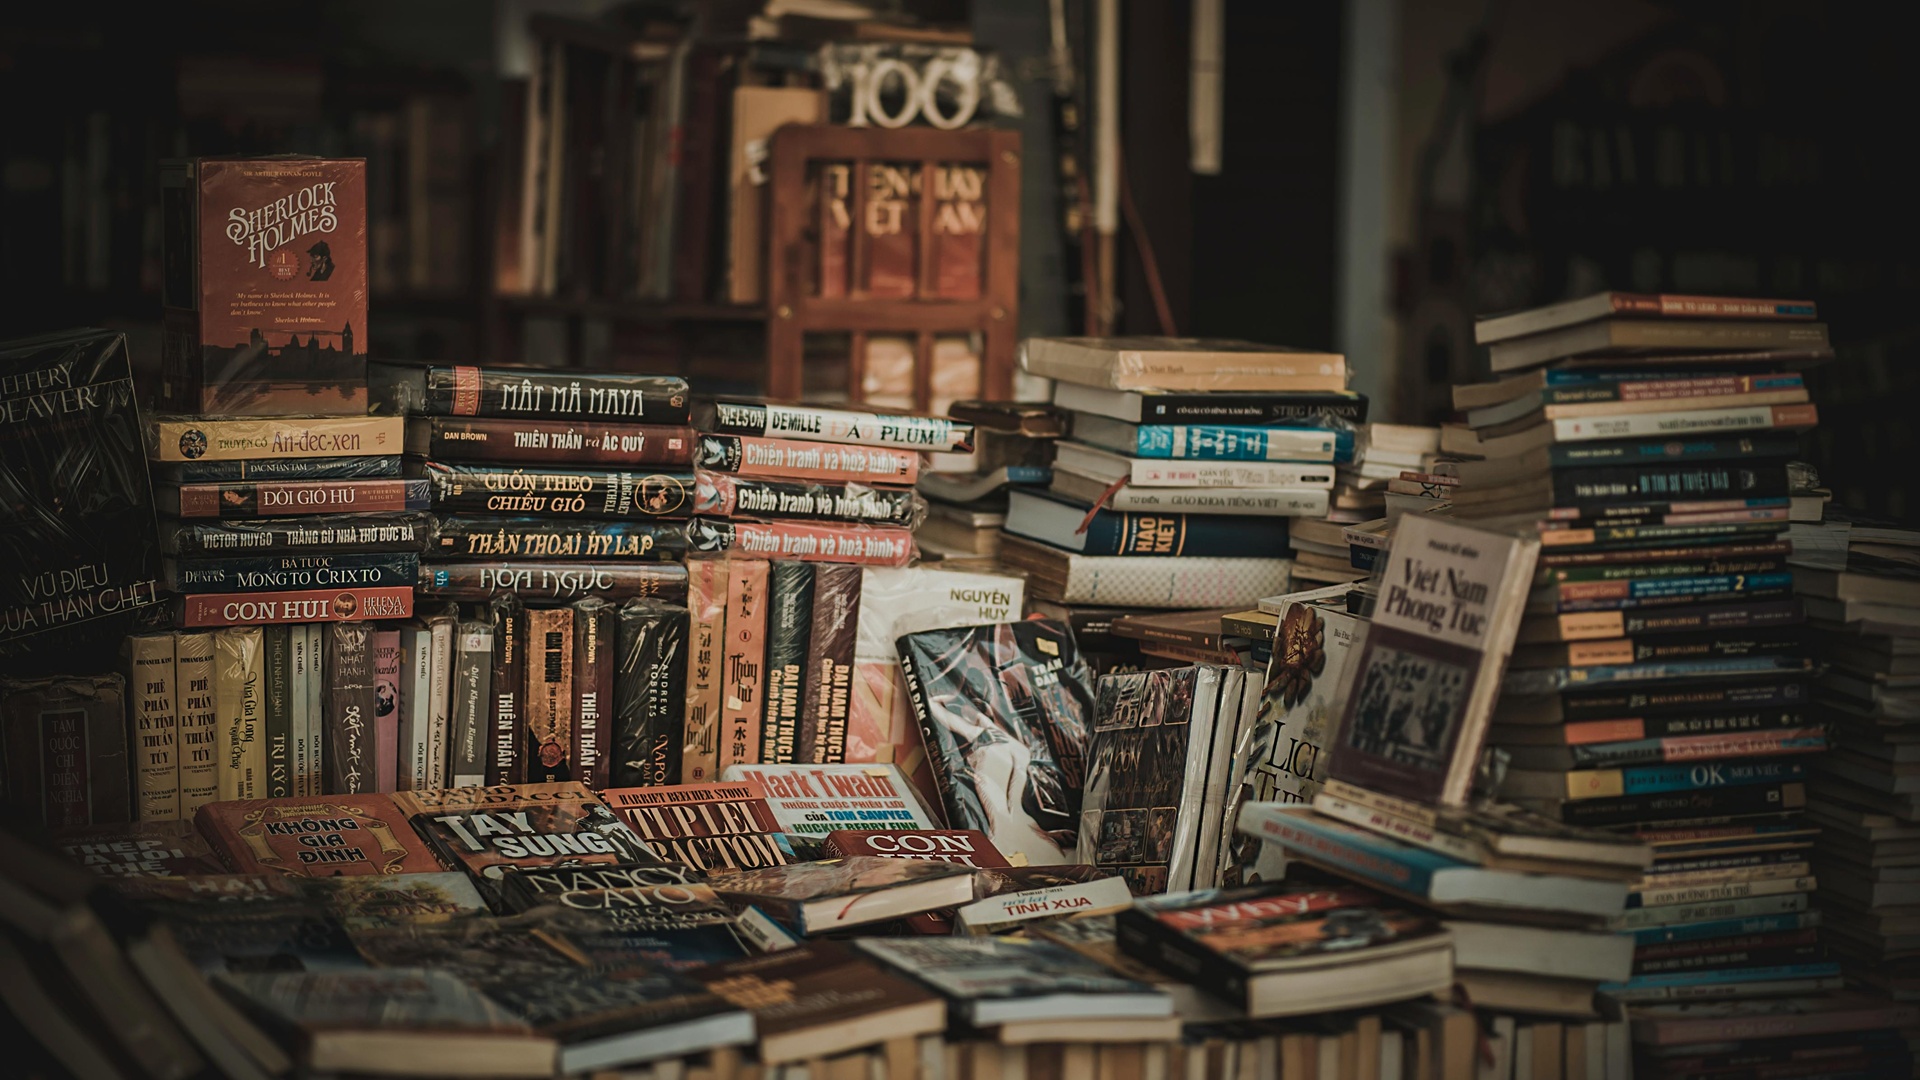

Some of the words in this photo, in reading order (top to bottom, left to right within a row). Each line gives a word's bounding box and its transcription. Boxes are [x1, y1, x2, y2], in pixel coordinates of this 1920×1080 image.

[848, 59, 980, 130] 100
[226, 182, 337, 245] SHERLOCK
[248, 206, 338, 269] HOLMES
[0, 362, 73, 394] EFFERY
[457, 379, 466, 408] BRIAN
[589, 388, 644, 416] MAYA
[1272, 405, 1305, 416] STIEG
[721, 407, 765, 429] NELSON
[772, 412, 822, 433] DEMILLE
[880, 425, 935, 444] PLUM
[444, 432, 458, 440] DAN
[460, 432, 487, 441] BROWN
[514, 429, 548, 448] THIÊN
[602, 432, 619, 451] ÁC
[746, 443, 784, 466] Chiến
[787, 450, 821, 469] tranh
[824, 453, 838, 470] và
[543, 475, 593, 492] THEO
[603, 473, 618, 513] MITCHELL
[618, 472, 632, 515] MARGARET
[550, 494, 586, 513] GIÓ
[739, 488, 777, 511] Chiến
[779, 491, 813, 513] tranh
[1197, 496, 1225, 506] KHOA
[203, 534, 238, 548] VICTOR
[240, 532, 273, 547] HUYGO
[337, 527, 356, 543] NHÀ
[401, 524, 415, 541] BÀ
[743, 529, 780, 552] Chiến
[784, 533, 817, 554] tranh
[821, 537, 834, 555] và
[1441, 568, 1488, 606] Nam
[223, 601, 277, 621] CON
[363, 597, 401, 606] HELENA
[363, 605, 406, 615] MNISZEK
[979, 607, 1008, 620] HUY
[1385, 586, 1446, 634] Phong
[505, 618, 513, 633] DAN
[588, 618, 596, 633] DAN
[505, 635, 513, 664] BROWN
[471, 664, 480, 688] Dilgo
[649, 664, 658, 717] ROBERTS
[660, 664, 669, 715] ANDREW
[781, 688, 798, 717] NAM
[831, 688, 847, 717] NAM
[469, 691, 479, 727] Khyentse
[52, 719, 76, 732] TAM
[272, 733, 284, 759] TRI
[467, 727, 476, 763] Rinpoche
[743, 771, 812, 798] Mark
[811, 771, 899, 798] Twain
[1690, 765, 1726, 785] OK
[619, 793, 666, 805] HARRIET
[667, 790, 715, 802] BEECHER
[714, 787, 752, 799] STOWE
[264, 818, 360, 835] KHÔNG
[805, 811, 828, 822] CỦA
[825, 811, 859, 820] TOM
[859, 811, 913, 820] SAWYER
[298, 833, 347, 847] GIA
[434, 812, 536, 851] TAY
[866, 835, 976, 852] CON
[297, 847, 367, 863] ĐÌNH
[527, 866, 692, 893] NANCY
[560, 885, 695, 910] CATO
